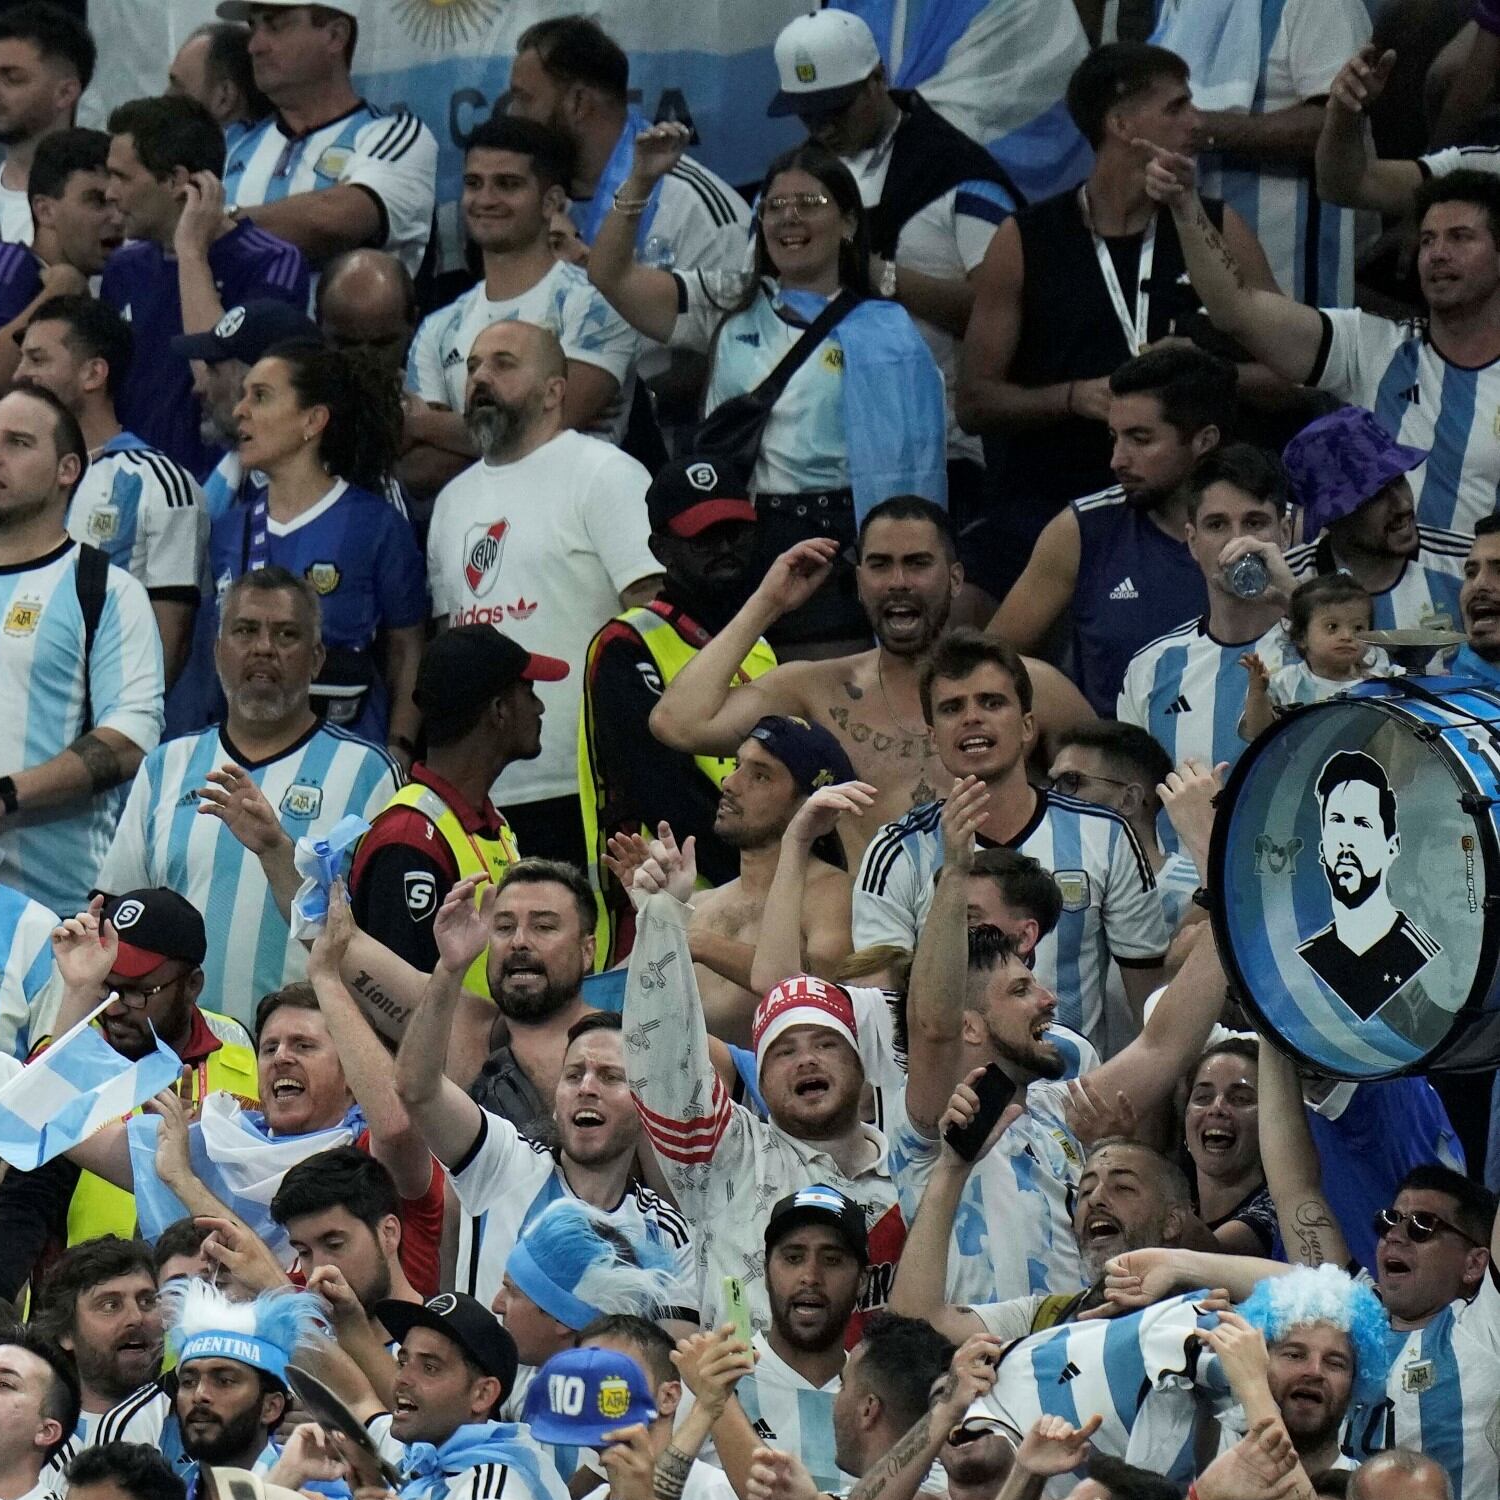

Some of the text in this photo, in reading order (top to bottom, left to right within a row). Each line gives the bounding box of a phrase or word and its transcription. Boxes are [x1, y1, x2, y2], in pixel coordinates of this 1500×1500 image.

[1109, 590, 1138, 599] adidas
[351, 969, 413, 1025] Lionel
[558, 1374, 597, 1417] 10
